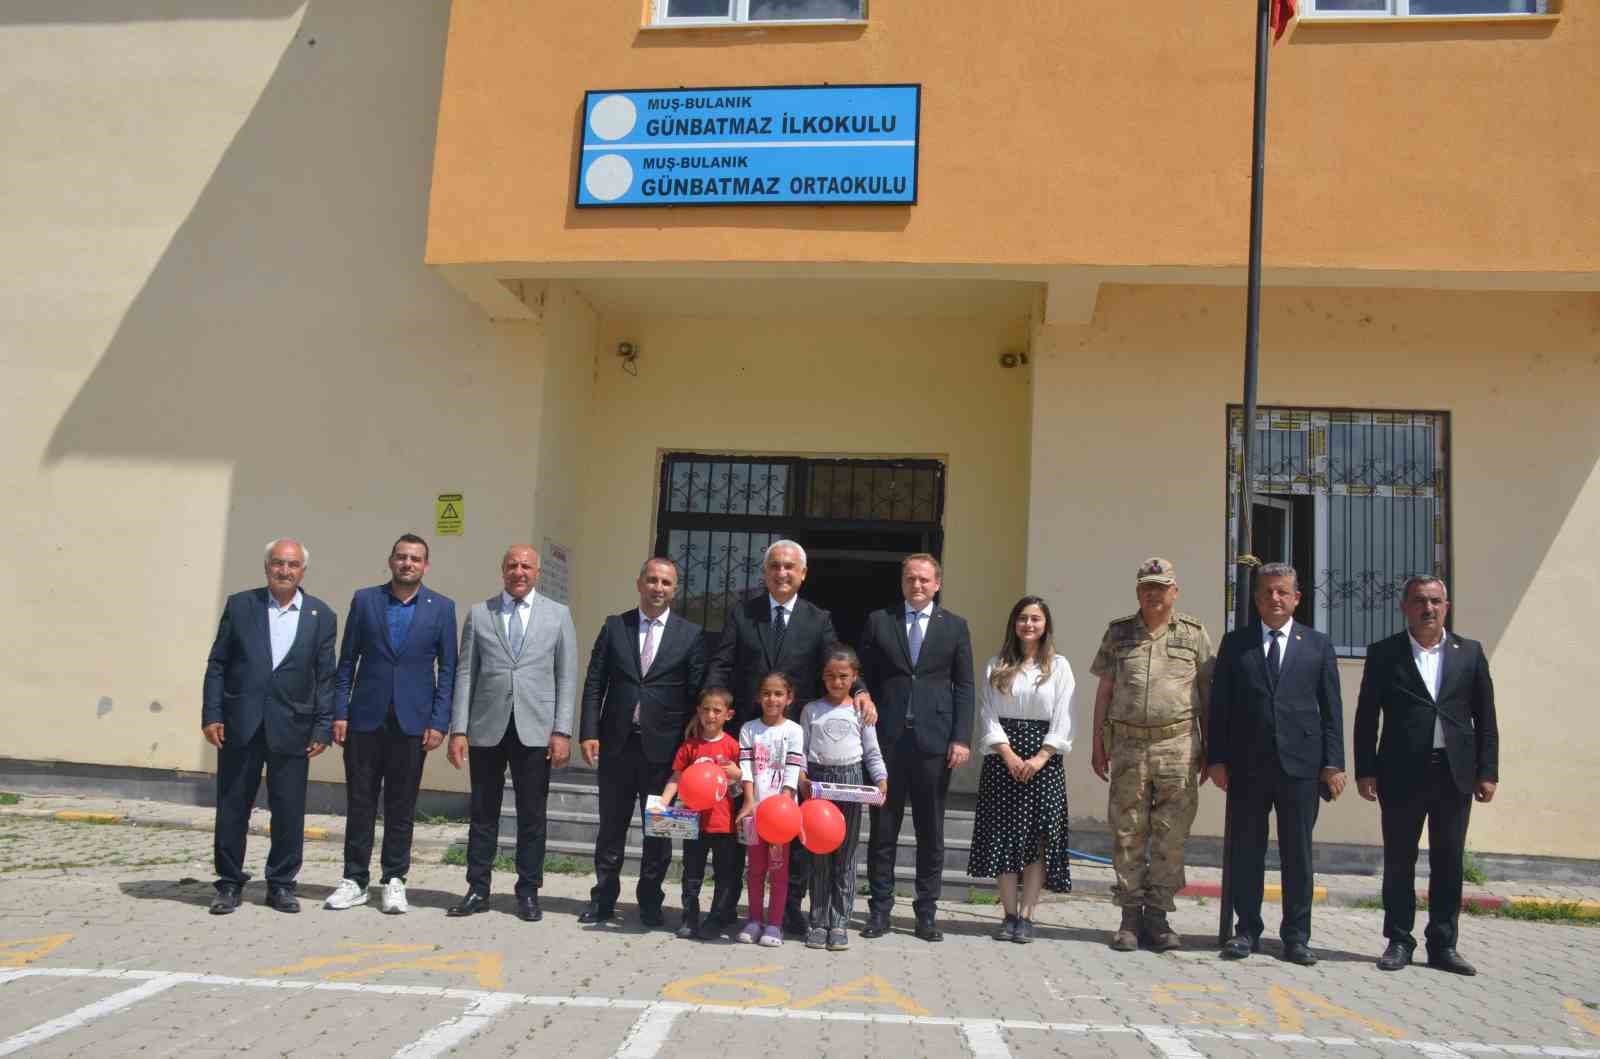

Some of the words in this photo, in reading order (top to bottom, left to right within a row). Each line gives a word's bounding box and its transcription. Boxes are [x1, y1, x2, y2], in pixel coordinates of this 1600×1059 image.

[648, 97, 752, 111] MUŞ-BULANIK
[646, 116, 772, 137] GÜNBATMAZ
[782, 112, 897, 134] İLKOKULU
[643, 156, 749, 171] MUŞ-BULANIK
[641, 175, 780, 197] GÜNBATMAZ
[790, 176, 906, 195] ORTAOKULU
